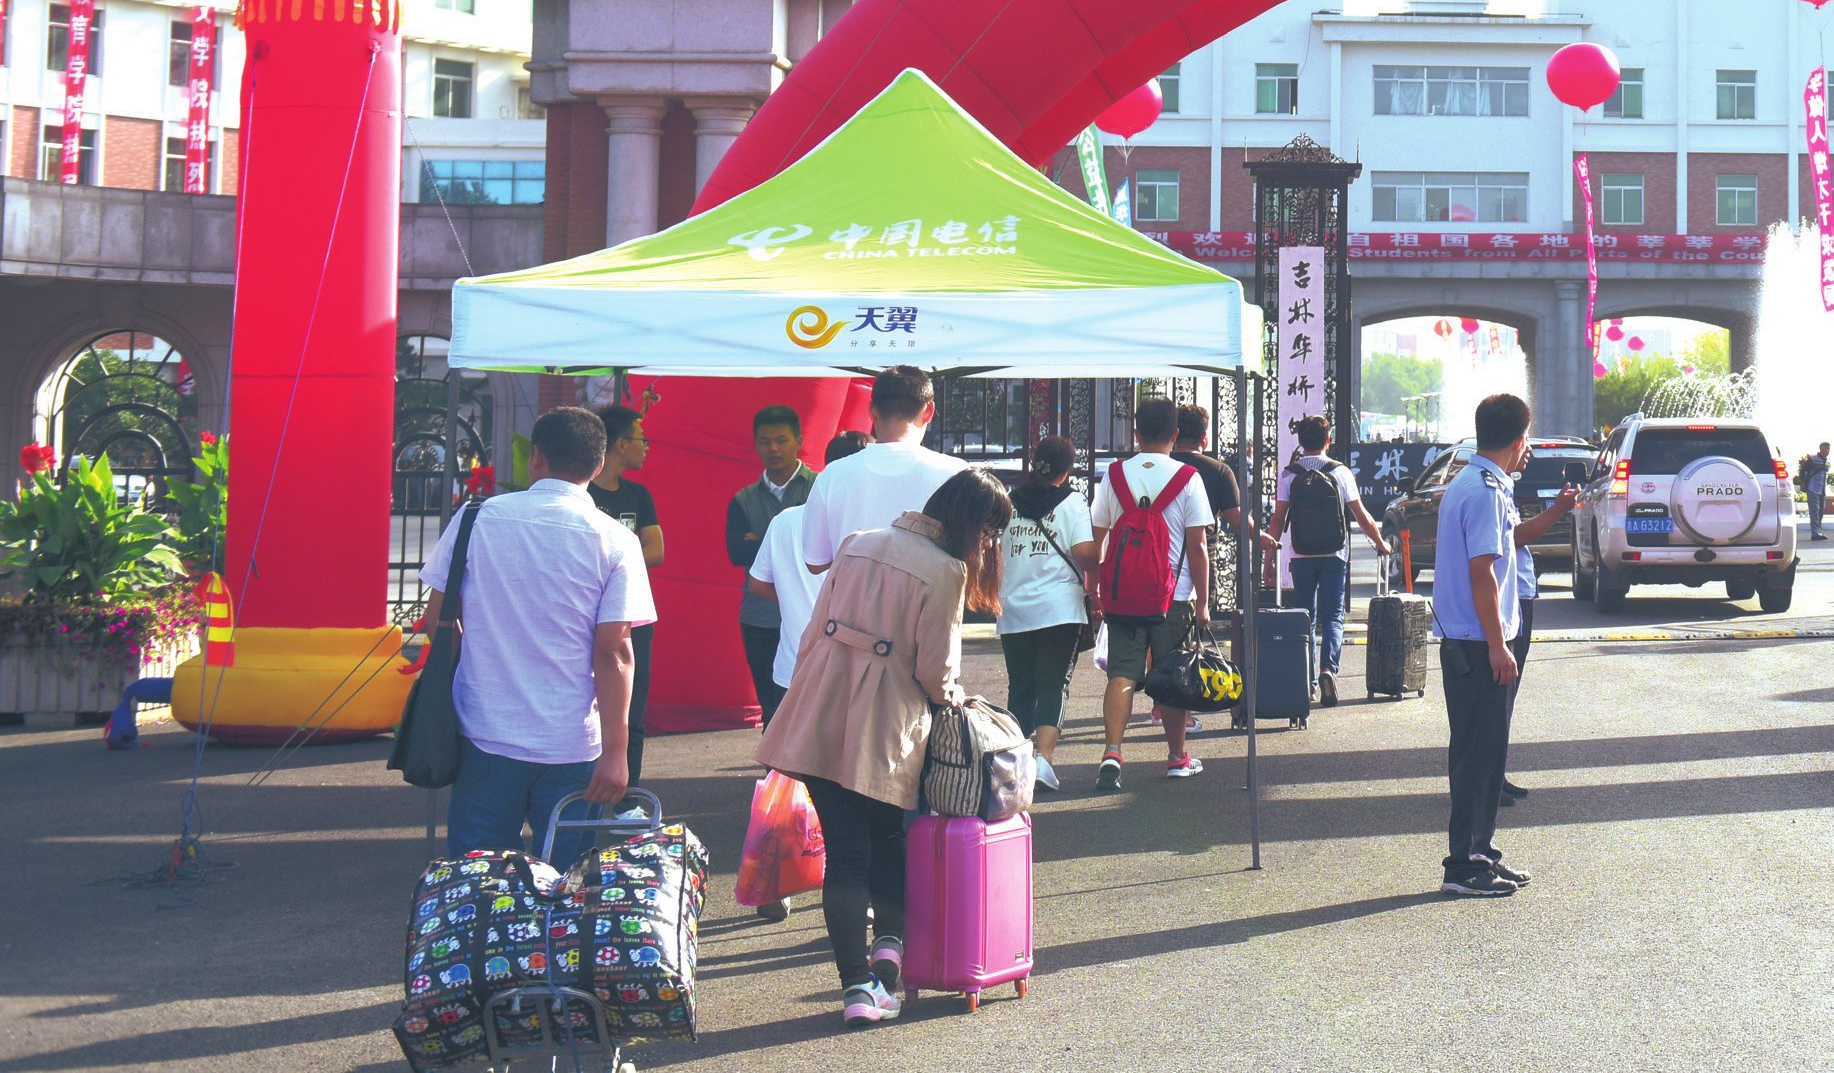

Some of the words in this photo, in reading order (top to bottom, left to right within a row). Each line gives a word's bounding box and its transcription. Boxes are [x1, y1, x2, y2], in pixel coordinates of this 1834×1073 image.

[828, 214, 1022, 251] 中国电信
[823, 248, 897, 260] CHINA
[906, 244, 1017, 258] TELECOM
[1349, 248, 1453, 258] Students
[1464, 249, 1516, 258] from
[1527, 248, 1557, 258] All
[1640, 250, 1663, 259] of
[1673, 250, 1709, 260] the
[1720, 250, 1766, 260] Cou
[849, 306, 919, 333] 天翼
[850, 339, 916, 348] 分享无限
[1697, 487, 1743, 496] PRADO
